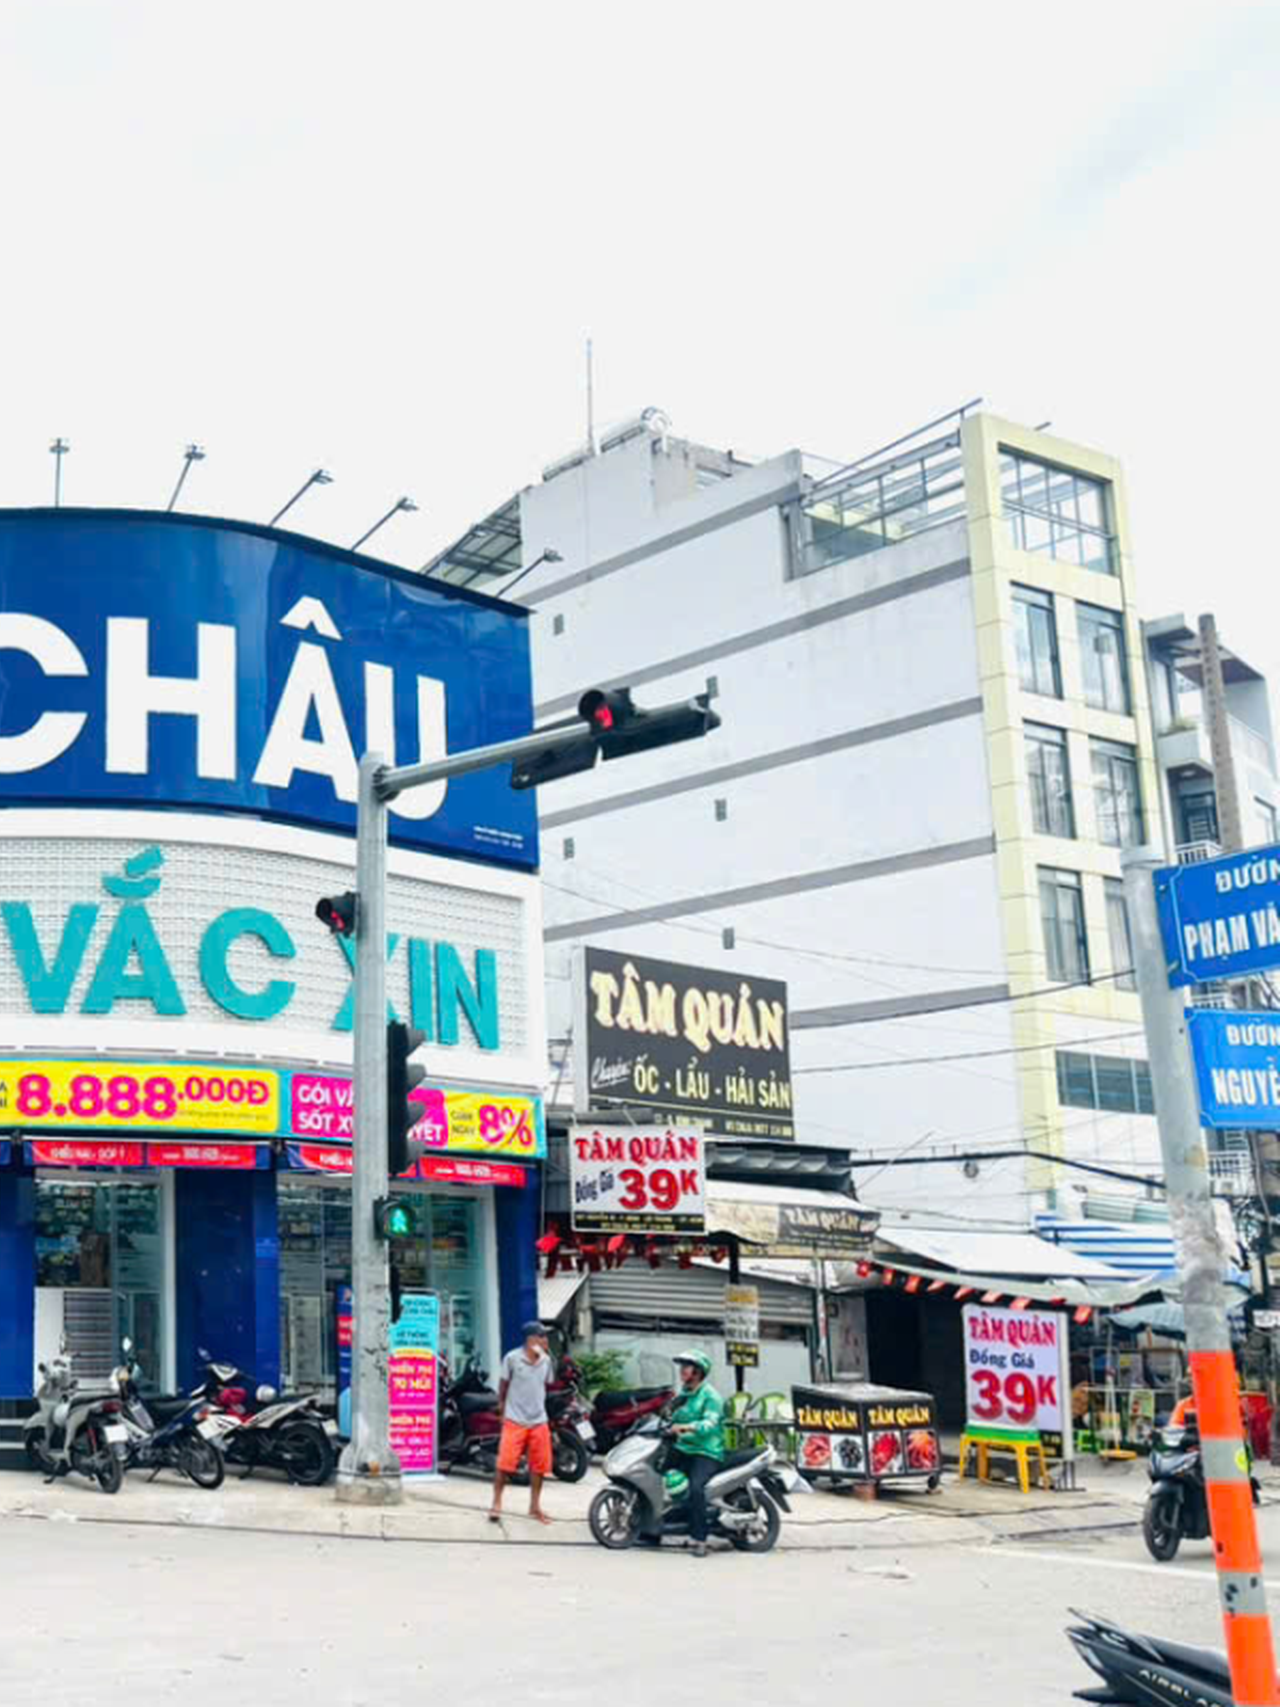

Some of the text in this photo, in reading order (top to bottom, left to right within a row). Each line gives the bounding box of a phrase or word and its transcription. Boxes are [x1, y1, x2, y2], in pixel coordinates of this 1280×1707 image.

[0, 845, 297, 1020] VẮC
[1184, 914, 1250, 961] PHẠM
[590, 961, 785, 1053] TÂM QUÁN
[297, 1078, 330, 1105] GÓI
[633, 1053, 660, 1094] ỐC
[675, 1057, 710, 1100] LẨU
[725, 1066, 754, 1105] HẢI
[758, 1070, 791, 1109] SẢN
[479, 1104, 533, 1147] 8%
[575, 1130, 699, 1167] TÂM QUÁN
[968, 1311, 1057, 1348] TÂM QUÁN
